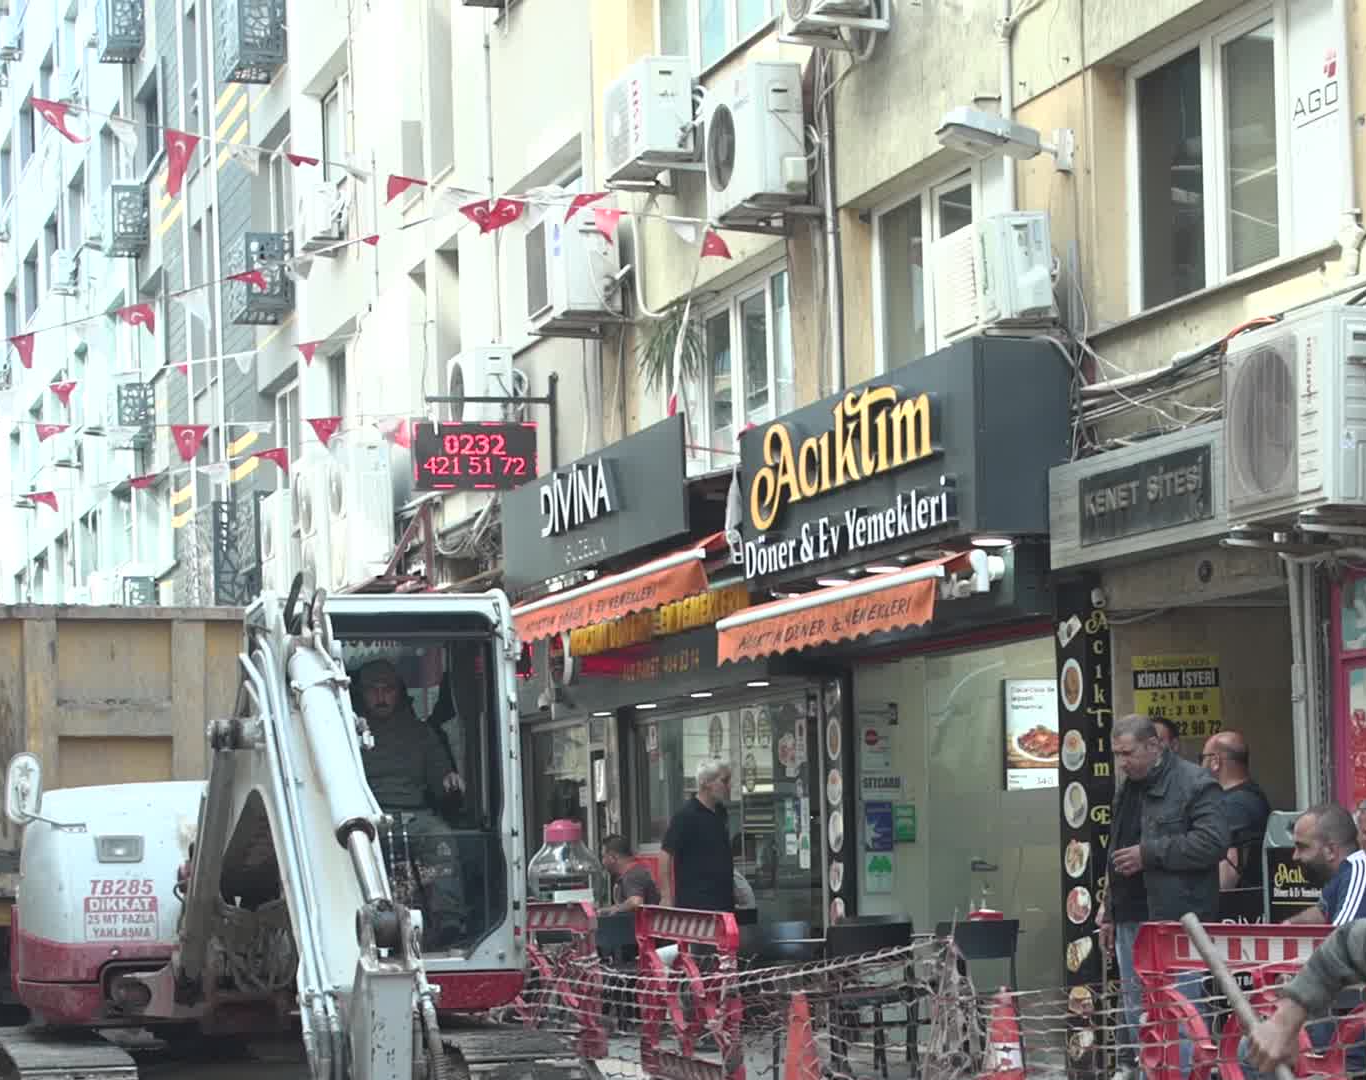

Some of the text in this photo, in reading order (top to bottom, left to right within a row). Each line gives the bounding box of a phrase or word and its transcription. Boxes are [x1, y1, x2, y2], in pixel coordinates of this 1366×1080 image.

[444, 434, 507, 455] 0232
[750, 386, 934, 531] Acıktım
[424, 457, 526, 475] 421 51 72
[1084, 481, 1139, 519] KENET
[745, 475, 948, 580] Döner & Ev Yemekleri
[90, 879, 154, 896] TB285
